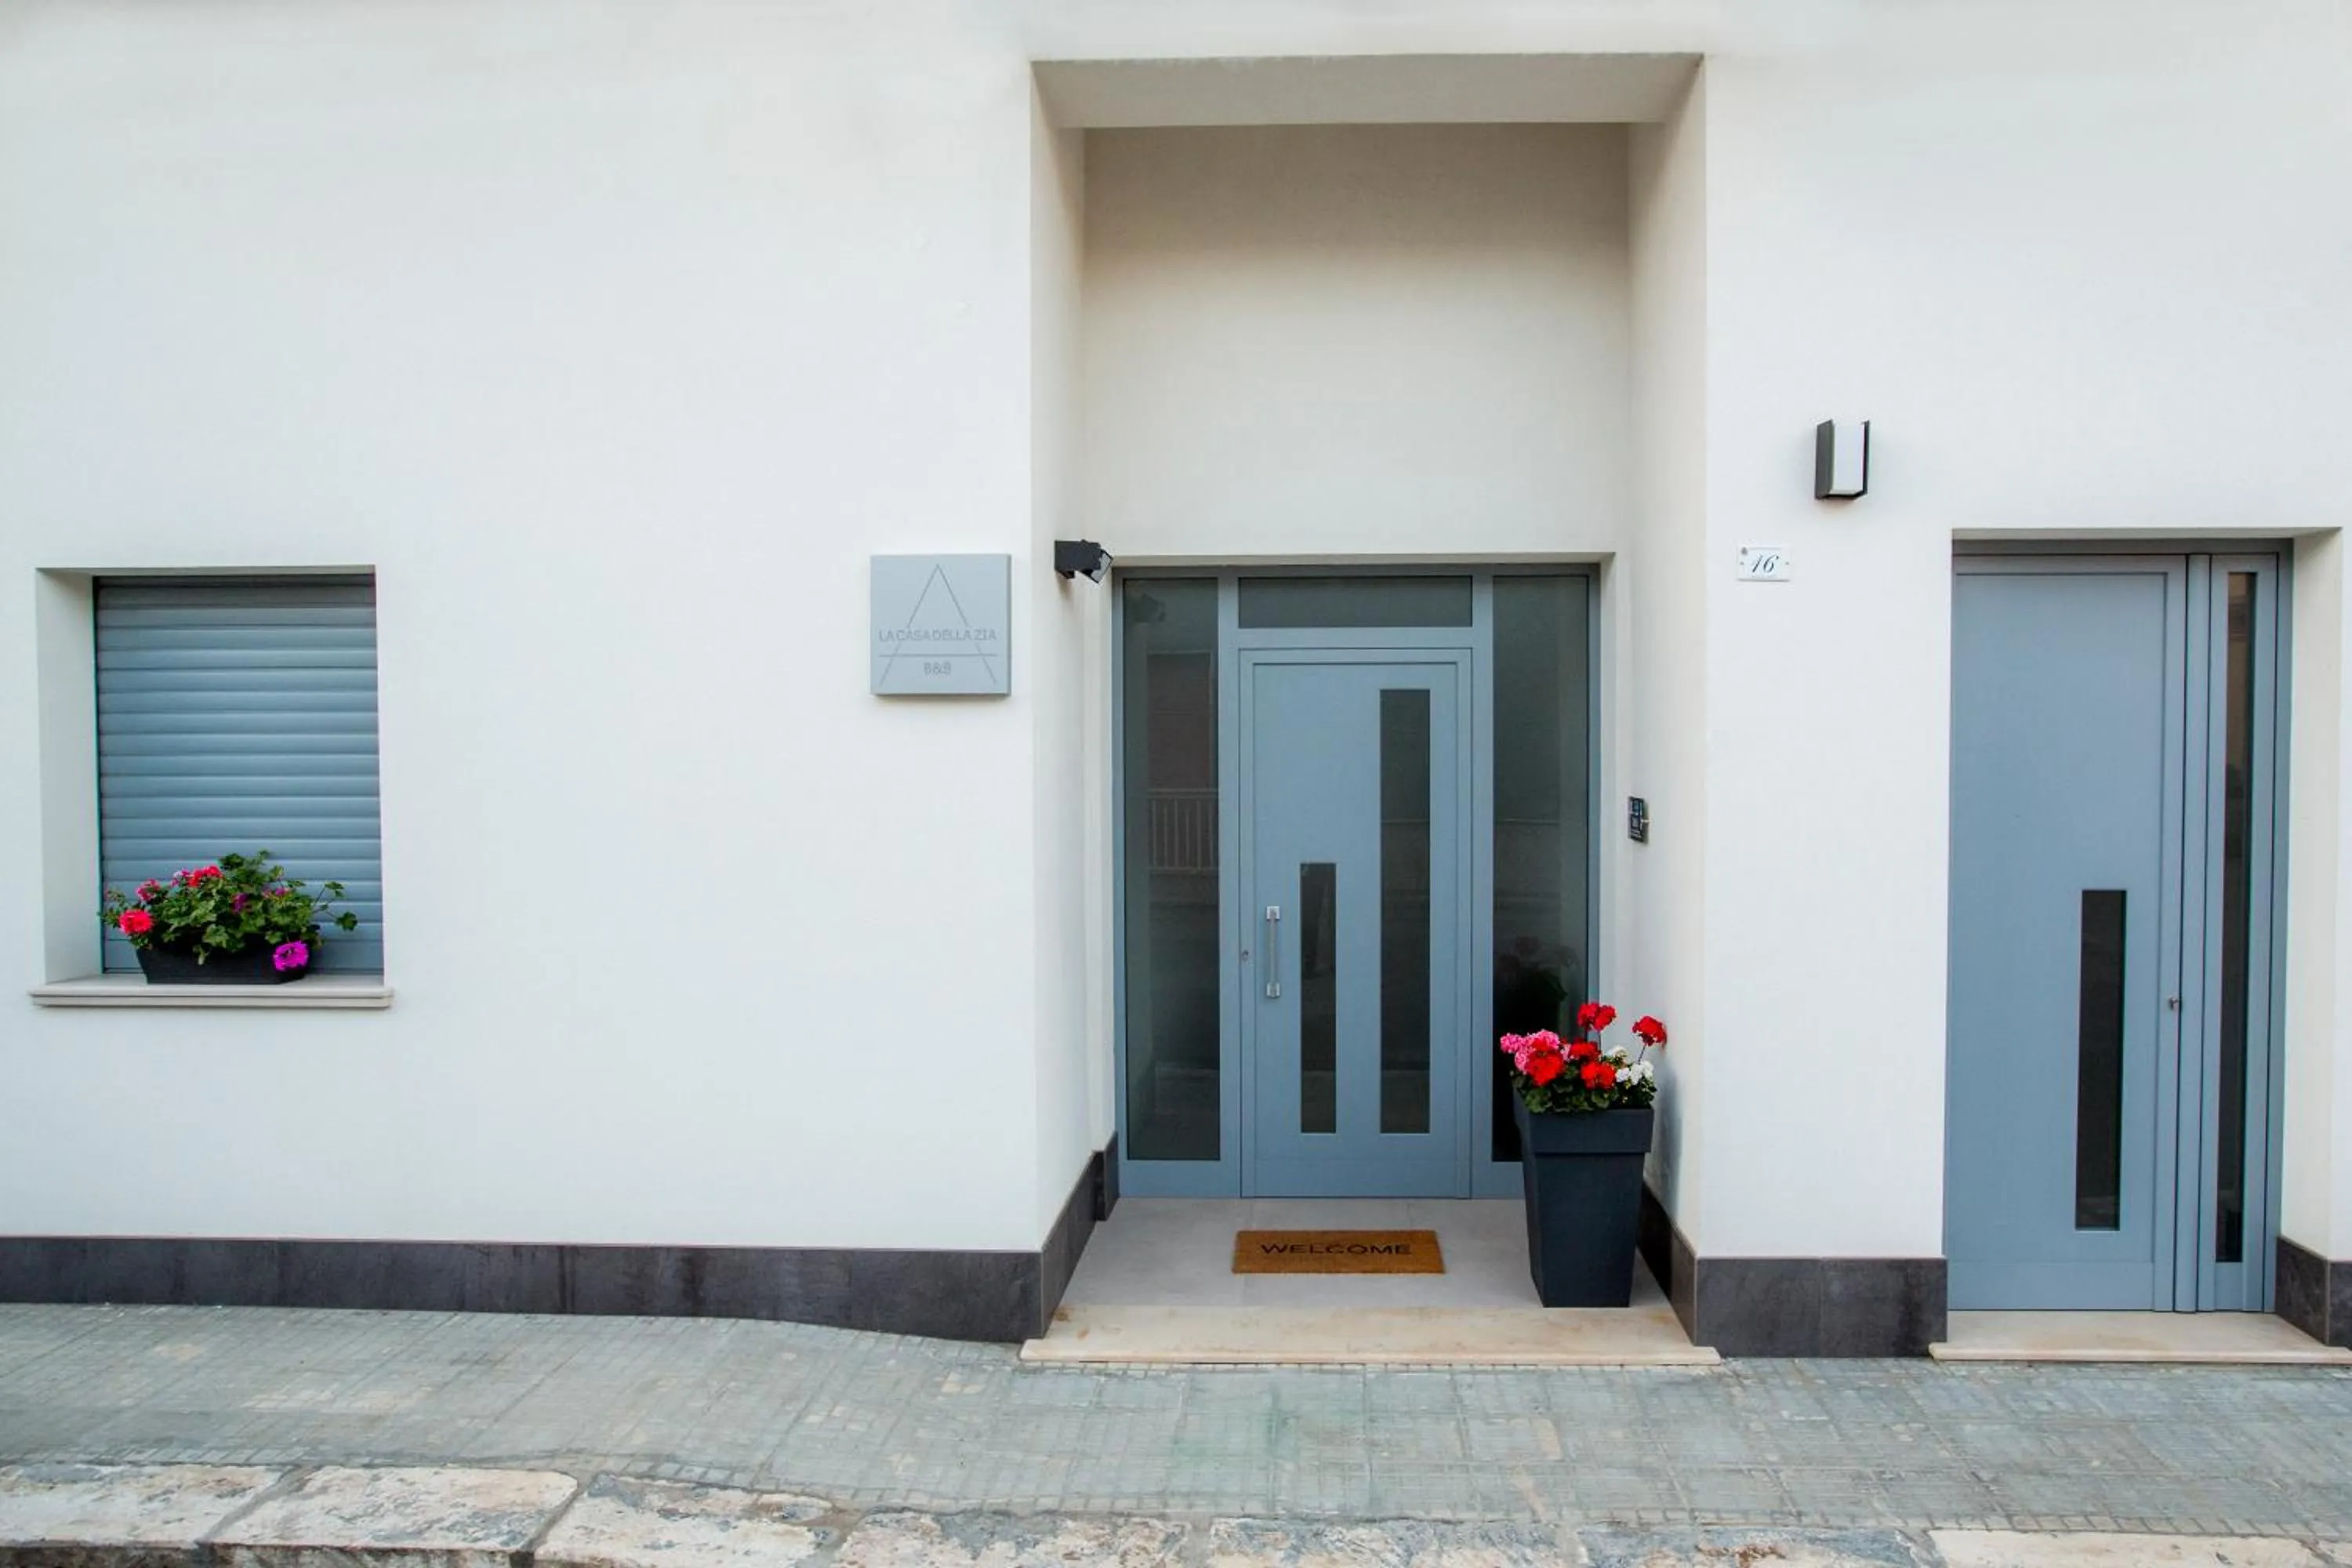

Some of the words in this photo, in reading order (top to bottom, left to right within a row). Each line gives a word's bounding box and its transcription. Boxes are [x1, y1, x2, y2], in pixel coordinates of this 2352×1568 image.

[1752, 554, 1779, 572] 16
[879, 630, 894, 642] LA
[896, 630, 931, 641] CASA
[932, 630, 971, 641] DELLA
[974, 630, 997, 641] ZIA
[924, 662, 952, 676] B&B
[1261, 1243, 1412, 1255] WELCOME
